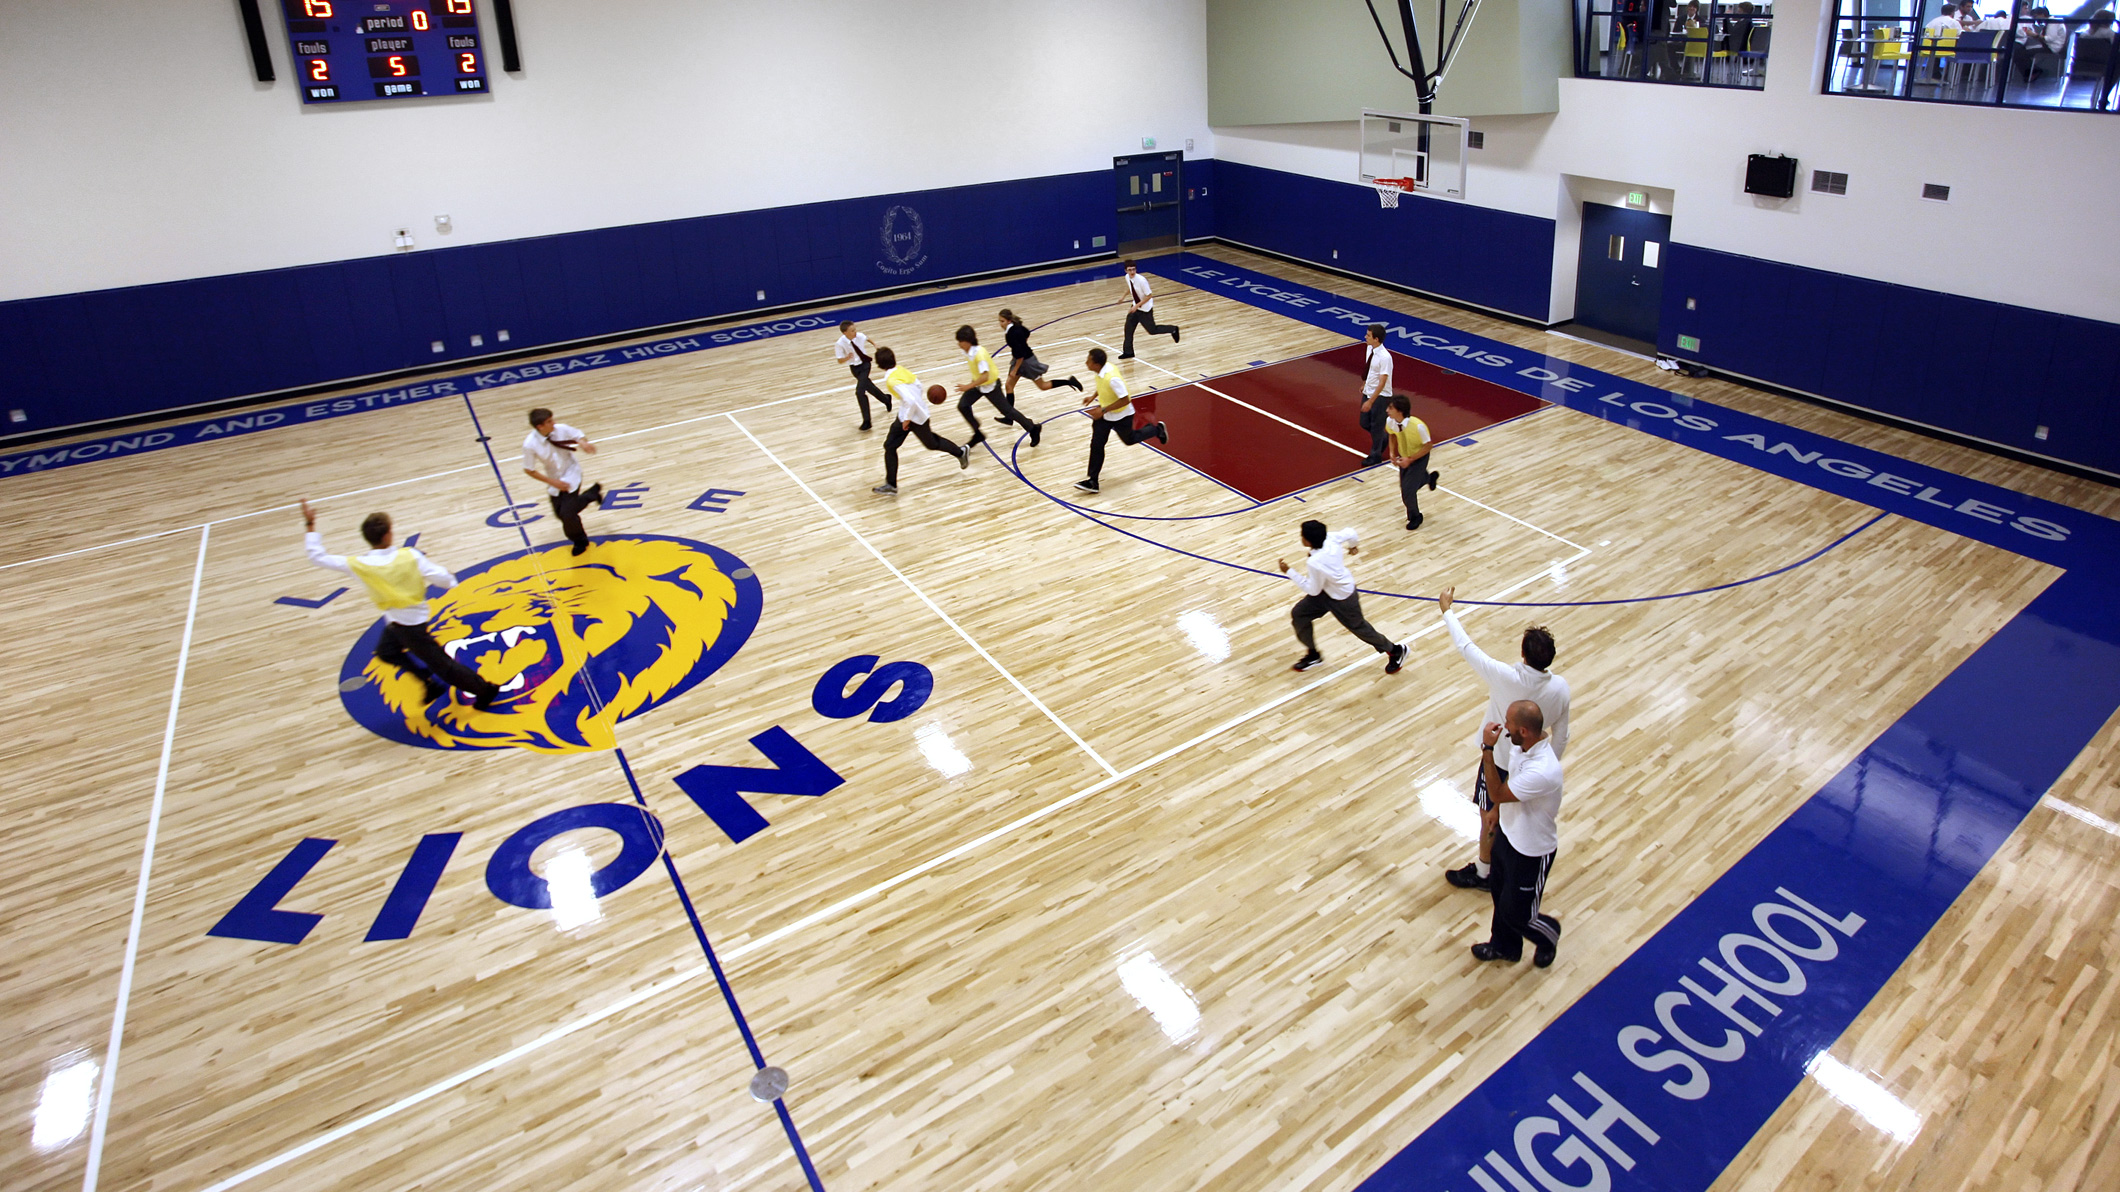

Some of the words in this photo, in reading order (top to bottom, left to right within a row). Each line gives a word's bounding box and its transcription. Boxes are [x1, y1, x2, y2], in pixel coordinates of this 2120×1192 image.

[366, 16, 404, 31] period
[411, 10, 429, 31] 0
[298, 42, 327, 54] fouls
[371, 39, 407, 52] player
[449, 36, 475, 48] fouls
[311, 59, 328, 80] 2
[389, 55, 406, 76] 5
[461, 53, 476, 73] 2
[310, 88, 335, 98] won
[384, 83, 412, 96] game
[459, 80, 481, 89] won
[1628, 192, 1643, 205] EXIT
[893, 231, 912, 242] 1964
[876, 260, 898, 275] Cogito
[899, 266, 915, 275] Ergo
[914, 254, 928, 268] Sum
[195, 412, 286, 438] AND
[305, 380, 458, 418] ESTHER
[474, 354, 611, 387] KABBAZ
[622, 338, 701, 359] HIGH
[711, 315, 836, 343] SCHOOL
[1181, 266, 1227, 279] LE
[1218, 276, 1321, 308] LYCÉE
[1516, 366, 1595, 393] DE
[1598, 391, 1719, 432] LOS
[1721, 433, 2072, 542] ANGELES
[273, 481, 747, 609] LCÉE
[206, 654, 934, 945] LIONS
[1617, 886, 1867, 1100] SCHOOL
